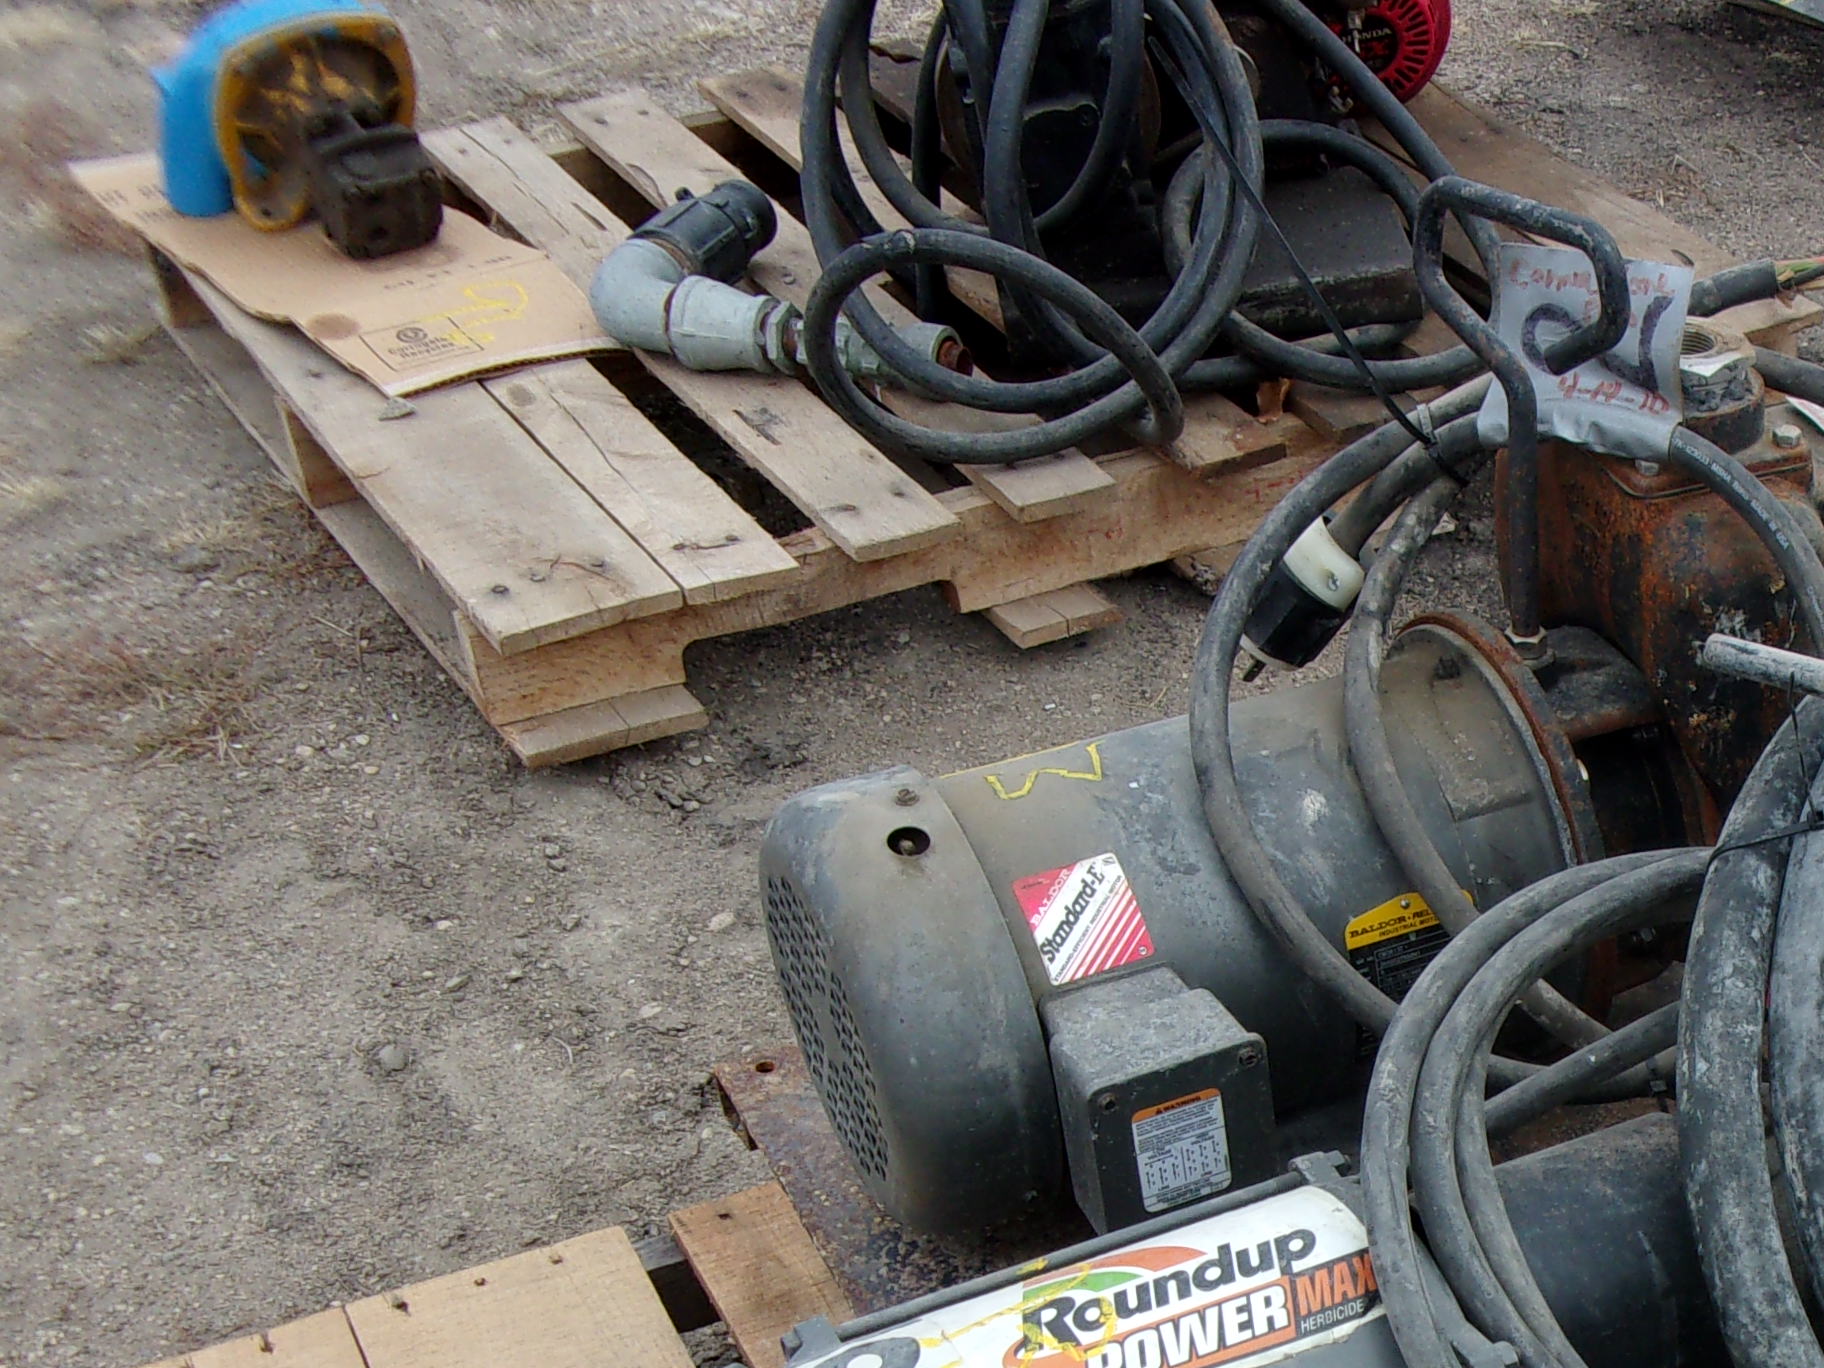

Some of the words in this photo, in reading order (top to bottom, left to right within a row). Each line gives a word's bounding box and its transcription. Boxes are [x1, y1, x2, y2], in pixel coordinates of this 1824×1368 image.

[1776, 530, 1790, 550] USA
[1030, 868, 1072, 926] BALDOR
[1040, 865, 1105, 965] Standard-E
[1349, 915, 1408, 939] BALDOR
[1022, 1228, 1317, 1354] Roundup
[1298, 1252, 1376, 1317] MAX
[1299, 1299, 1366, 1336] HERBICIDE
